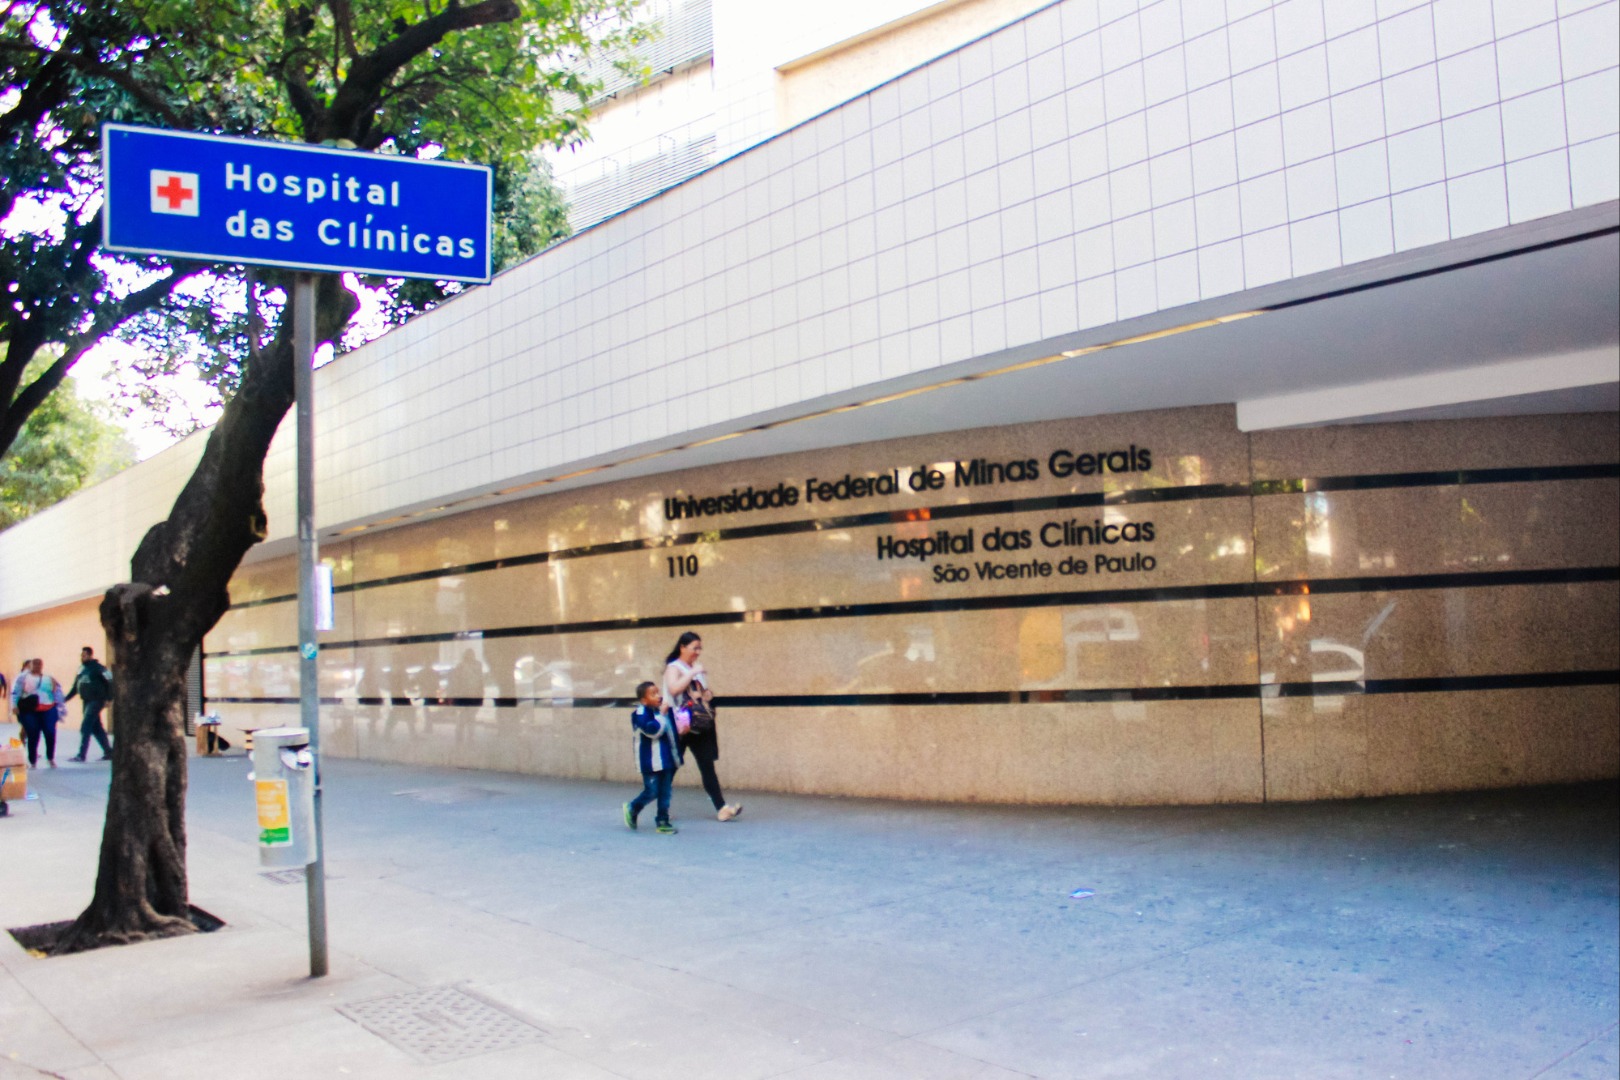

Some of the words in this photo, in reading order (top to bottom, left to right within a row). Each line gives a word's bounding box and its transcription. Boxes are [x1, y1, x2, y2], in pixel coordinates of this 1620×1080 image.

[225, 162, 400, 206] Hospital
[225, 210, 295, 242] das
[317, 213, 475, 259] Clínicas
[664, 484, 798, 521] Universidade
[805, 470, 899, 502] Federal
[909, 464, 945, 492] de
[954, 457, 1039, 488] Minas
[1048, 445, 1152, 478] Gerais
[877, 528, 974, 561] Hospital
[982, 524, 1032, 552] das
[1039, 518, 1155, 548] Clínicas
[666, 554, 698, 579] 110
[933, 562, 969, 584] São
[974, 558, 1052, 581] Vicente
[1058, 556, 1088, 577] de
[1095, 552, 1156, 574] Paulo
